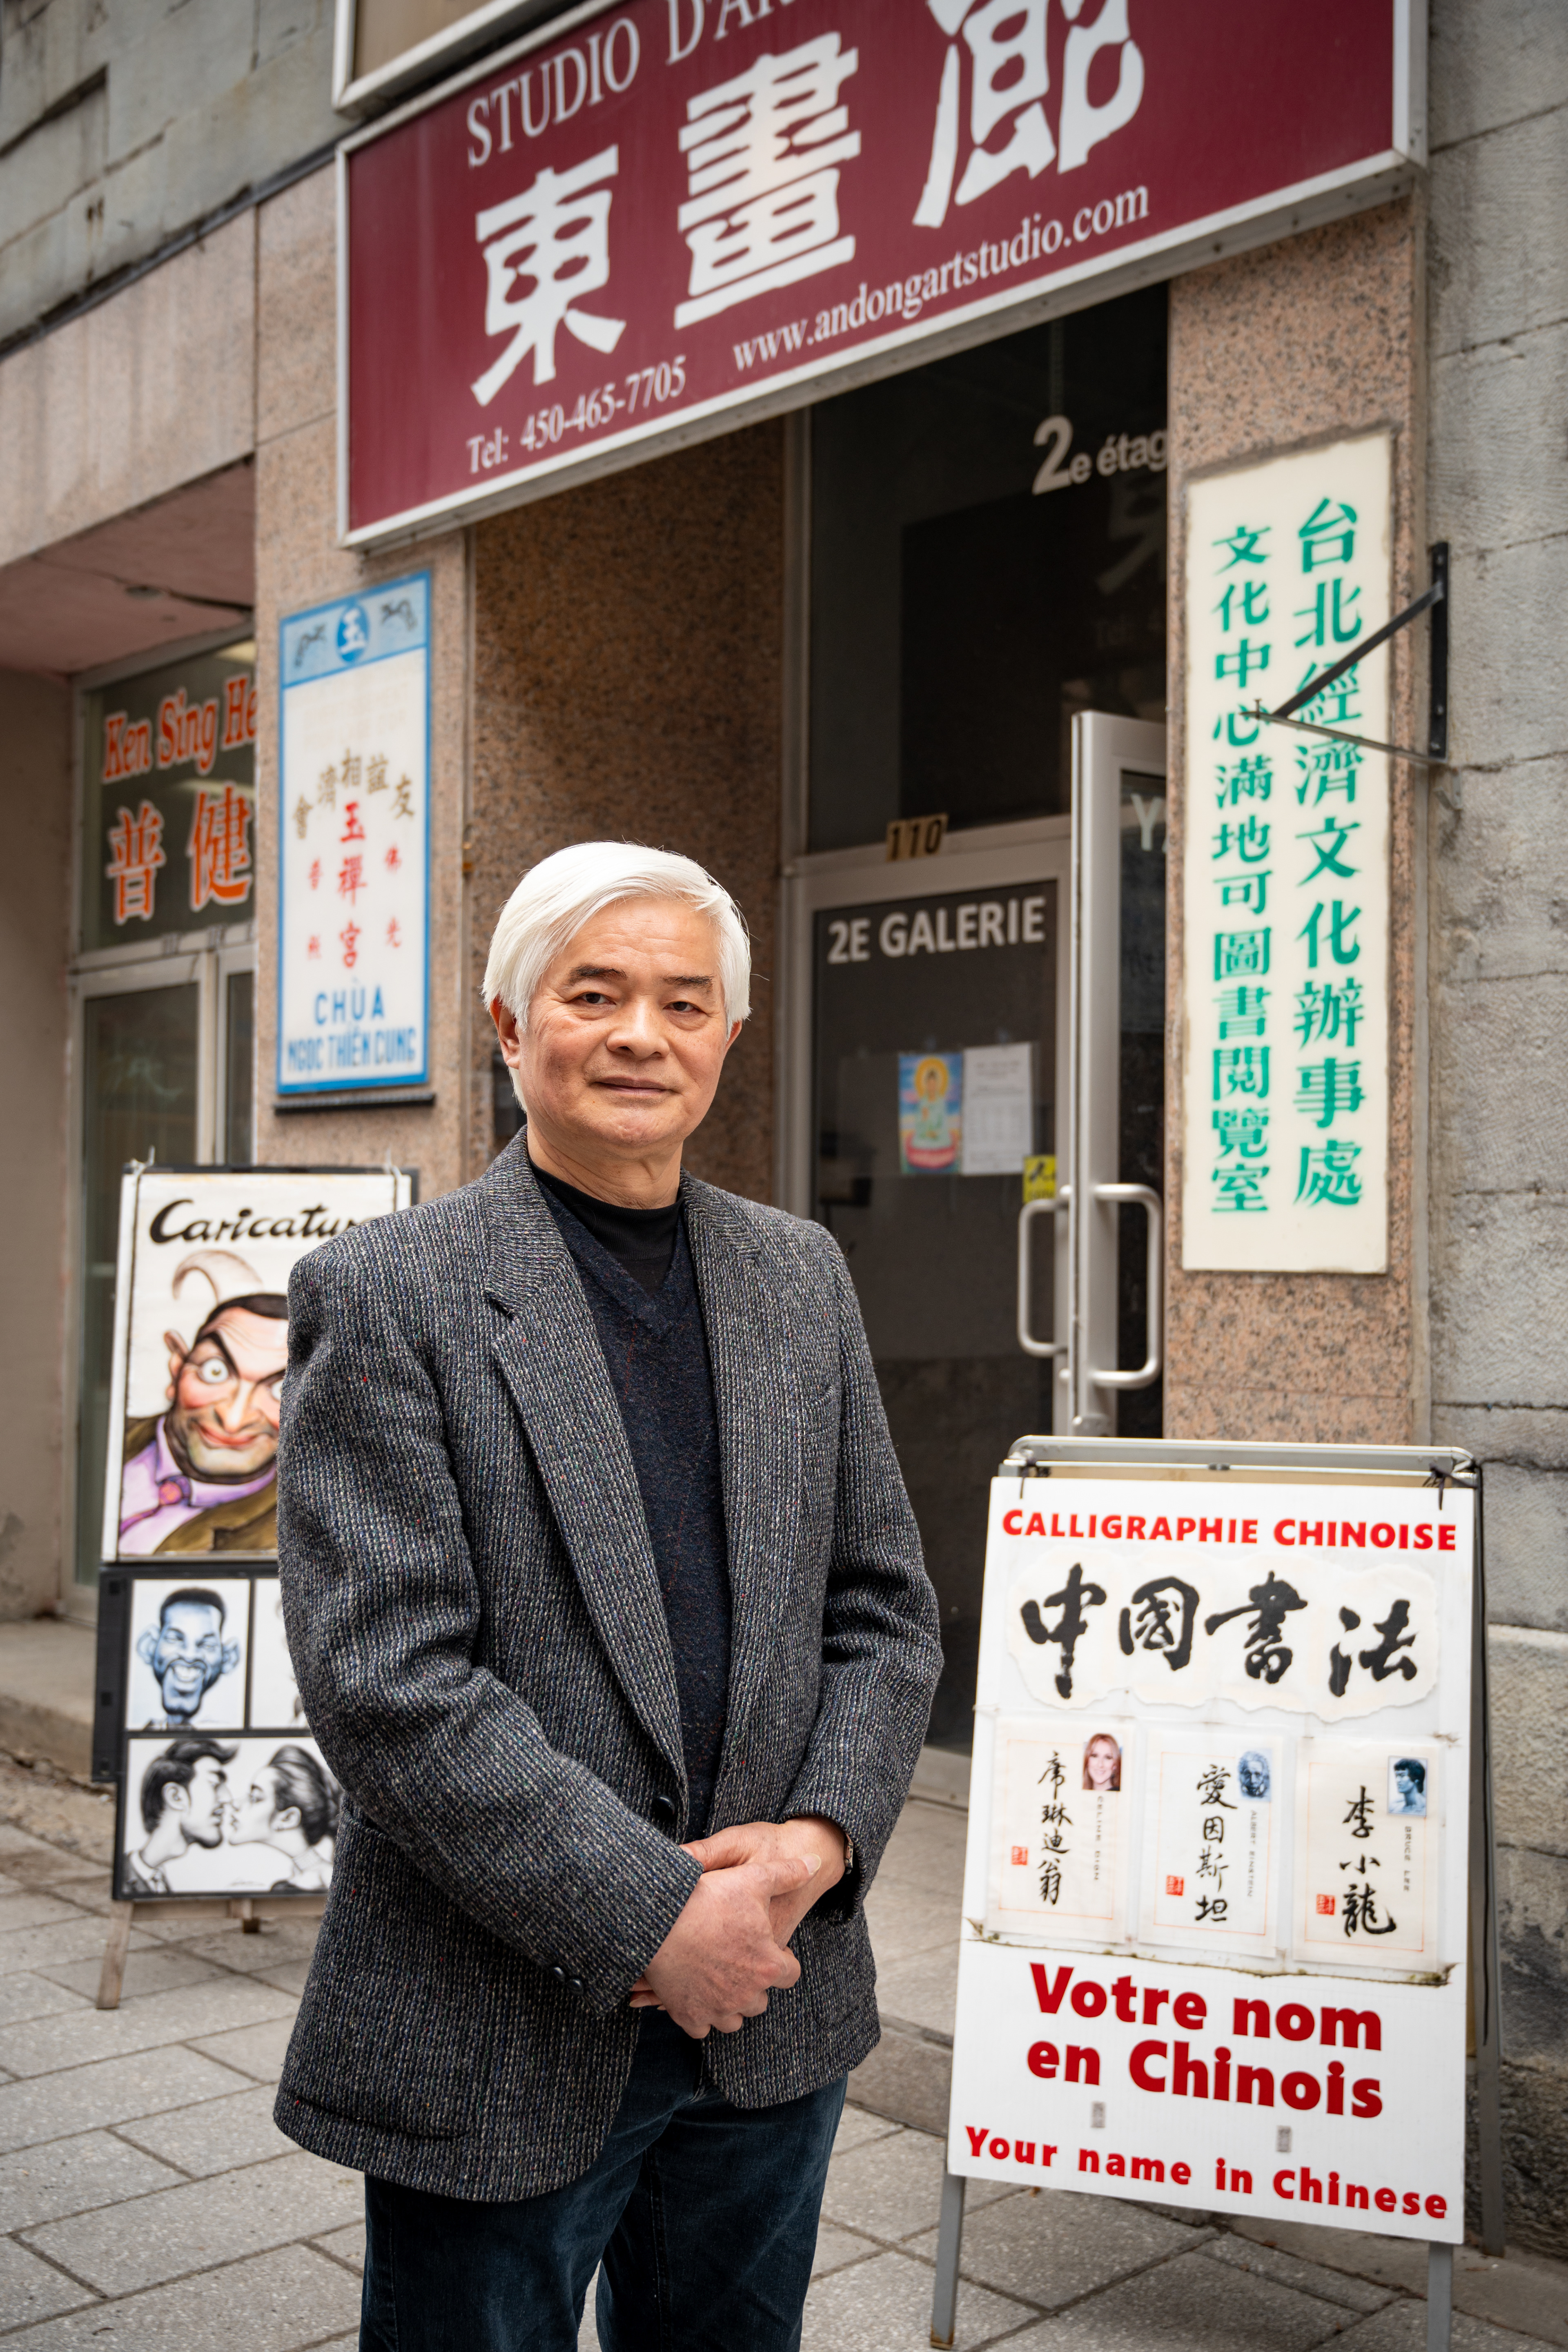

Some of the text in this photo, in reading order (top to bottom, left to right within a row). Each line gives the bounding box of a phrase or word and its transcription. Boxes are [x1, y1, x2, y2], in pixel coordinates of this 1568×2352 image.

[467, 17, 640, 168] STUDIO
[466, 185, 1149, 474] Tel: 450-465-7705 www.andongartstudio.com
[105, 713, 151, 781] Ken
[158, 688, 218, 773] Sing
[889, 818, 942, 860] 110
[1211, 526, 1273, 1213] 文化中心滿地可圖書閱覽室
[1293, 497, 1366, 1206] 台北經濟文化辦事處
[827, 896, 1046, 964] 2E GALERIE
[1003, 1509, 1456, 1551] CALLIGRAPHIE CHINOISE
[1020, 1562, 1417, 1699] 中國書法
[1095, 1795, 1103, 1842] CELINE
[1195, 1764, 1238, 1922] 愛因斯坦
[1339, 1785, 1396, 1938] 李小龍
[1029, 1962, 1382, 2051] Votre nom
[1027, 2039, 1383, 2118] en Chinois
[965, 2126, 1448, 2219] Your name in Chinese
